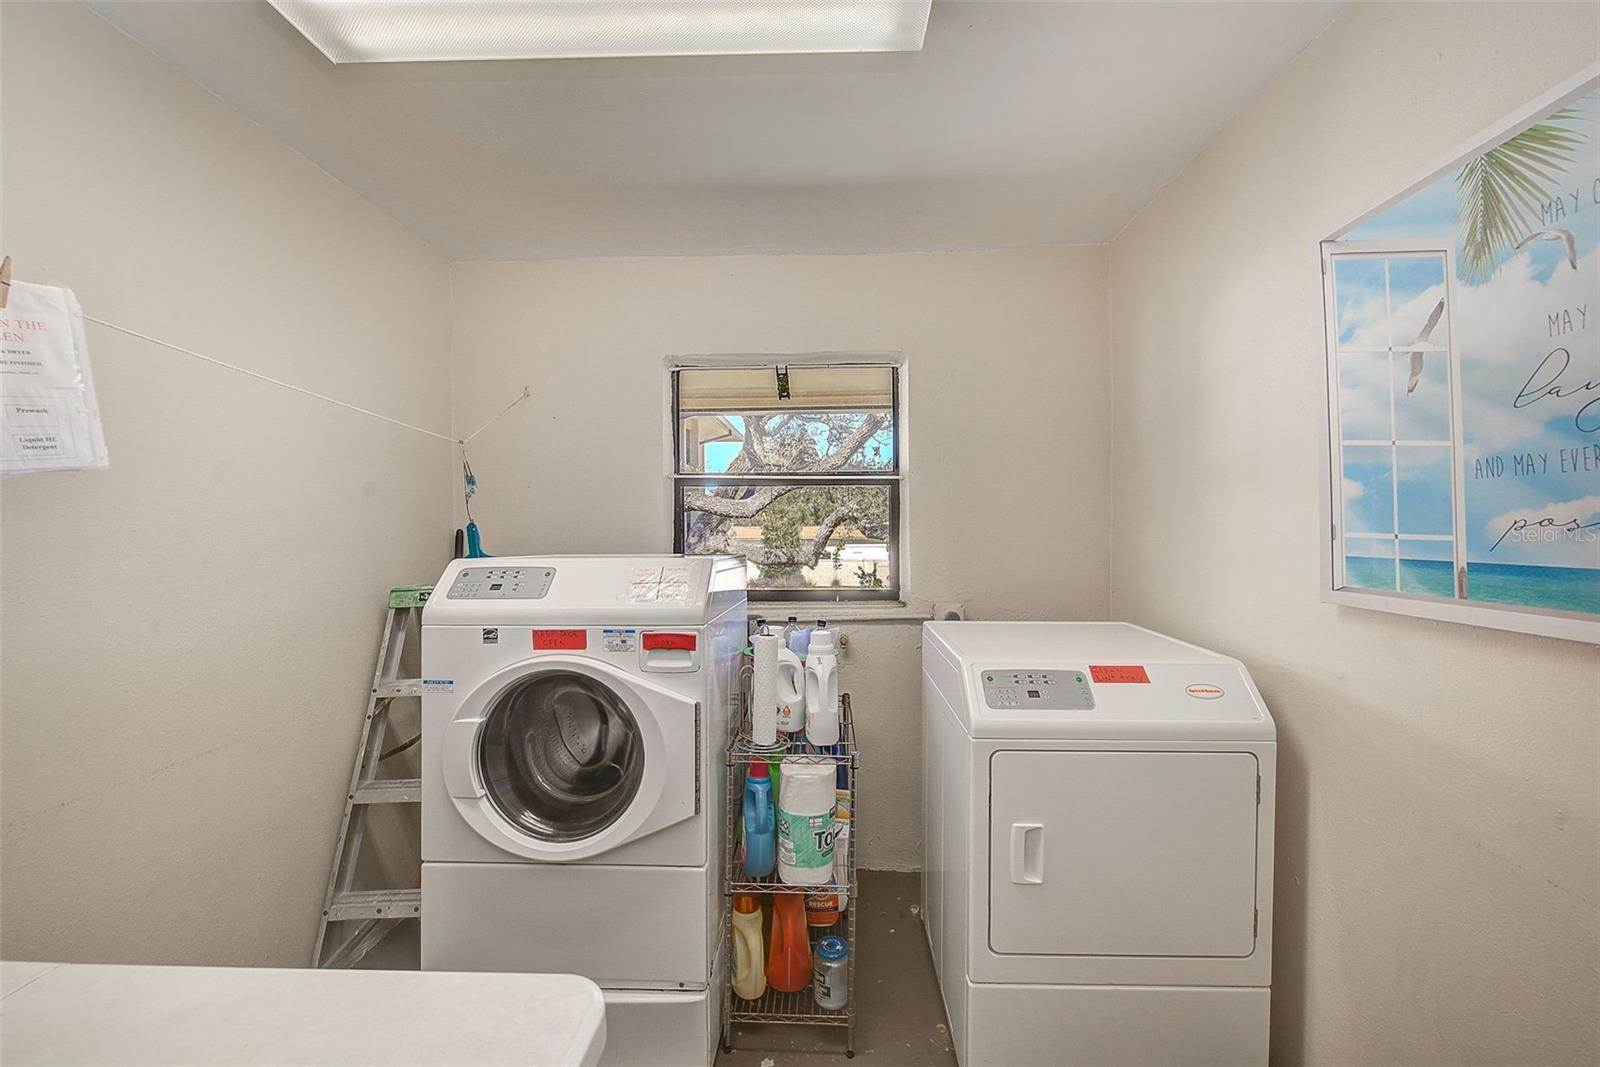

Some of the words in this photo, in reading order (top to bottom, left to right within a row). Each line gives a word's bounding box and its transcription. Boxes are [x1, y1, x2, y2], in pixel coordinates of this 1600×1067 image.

[1541, 188, 1580, 226] MAY
[14, 319, 47, 331] THE
[1548, 304, 1587, 337] MAY
[19, 436, 44, 444] Liquid
[1475, 455, 1504, 480] AND
[1513, 452, 1547, 477] MAY
